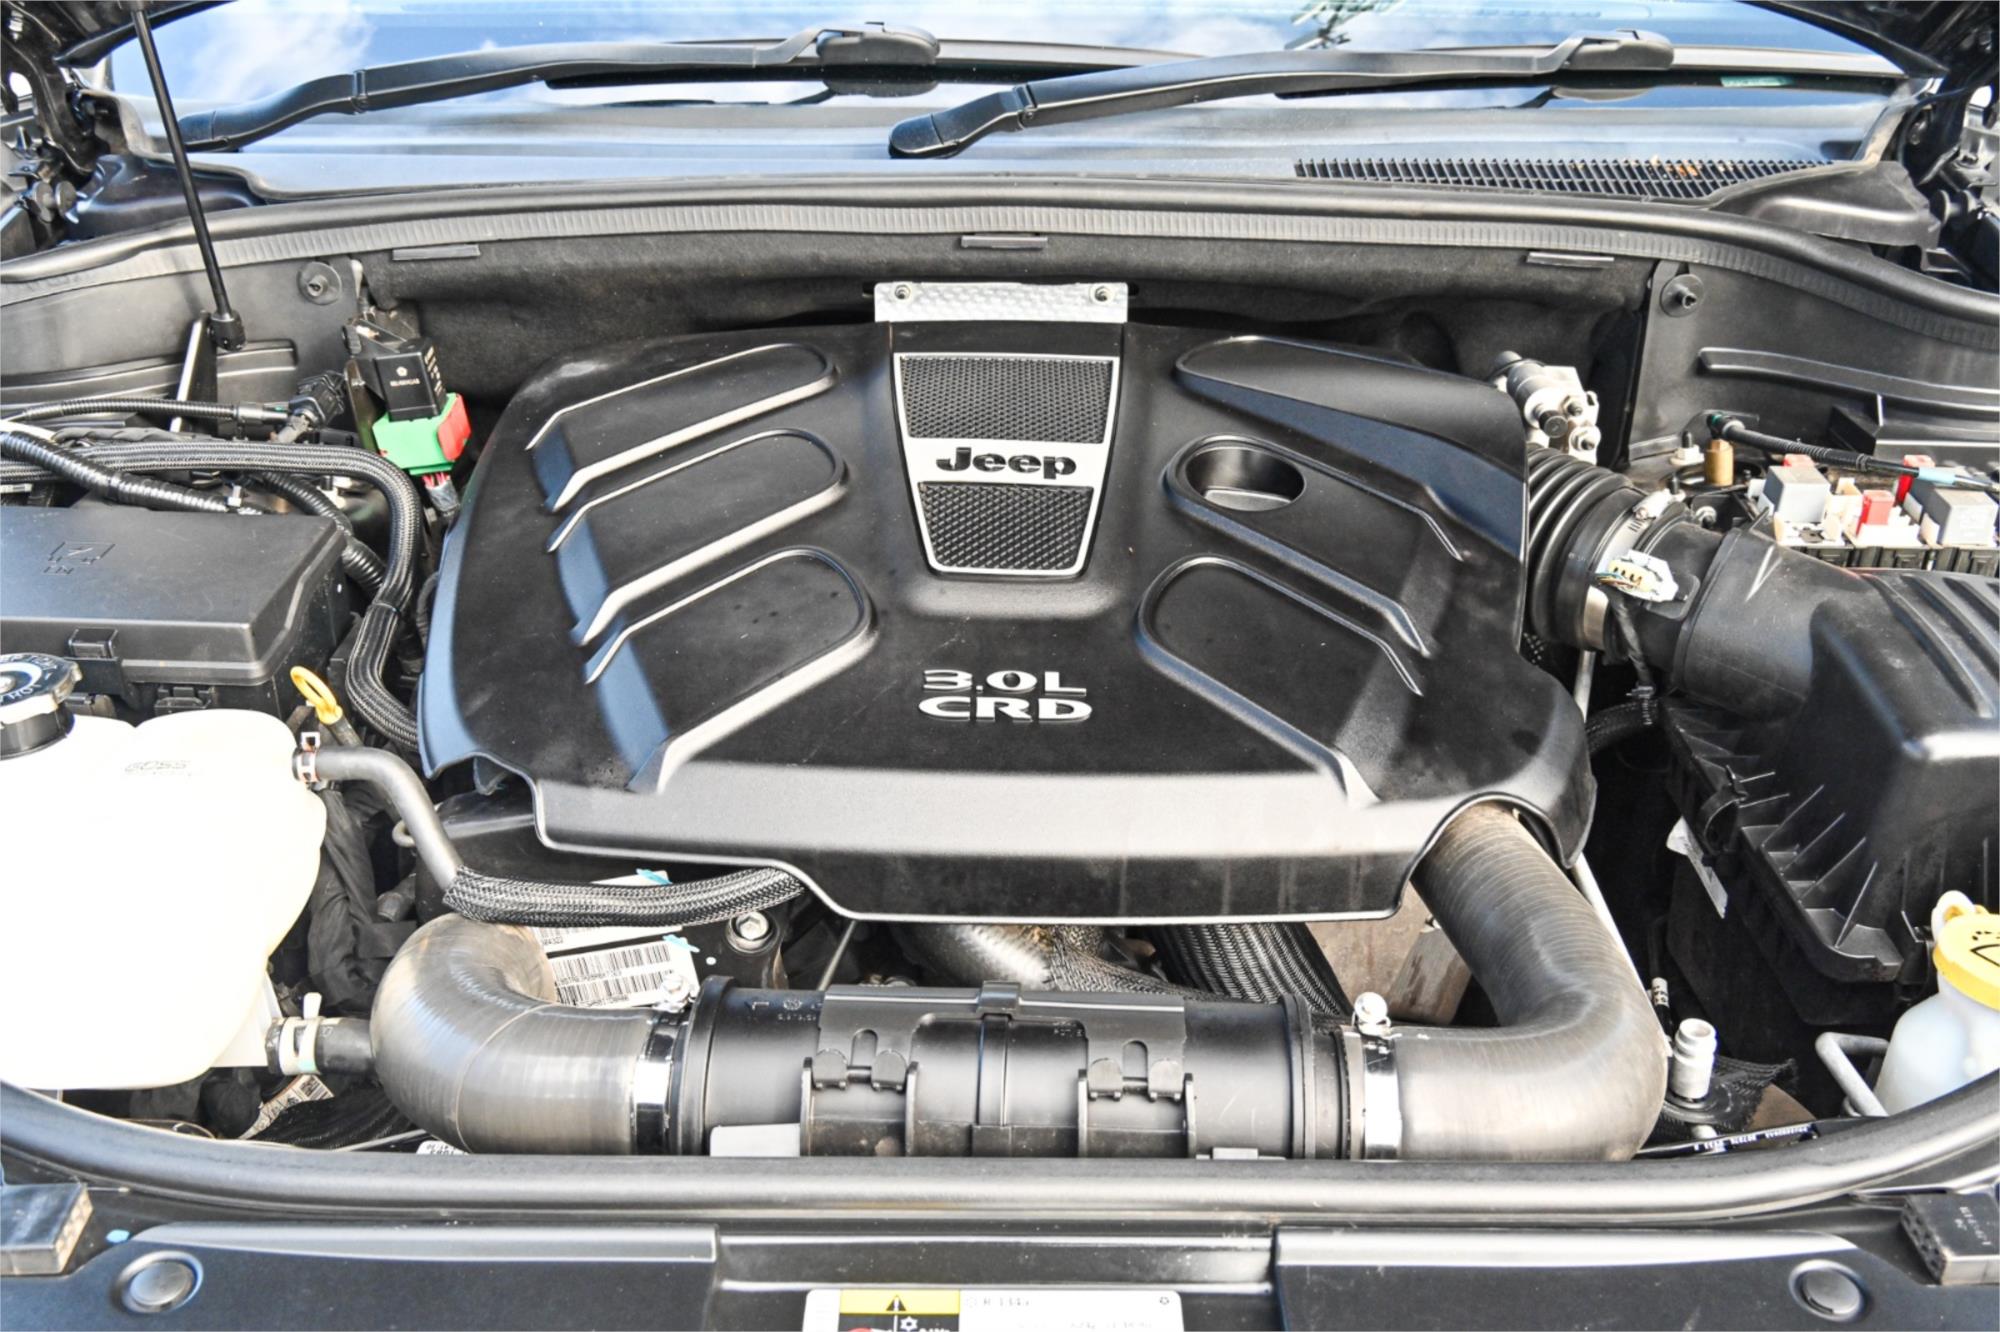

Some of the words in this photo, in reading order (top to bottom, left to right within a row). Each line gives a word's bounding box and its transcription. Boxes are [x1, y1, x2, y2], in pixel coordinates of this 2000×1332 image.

[936, 447, 1077, 480] Jeep
[923, 669, 1088, 696] 3.0L
[918, 696, 1093, 722] CRD
